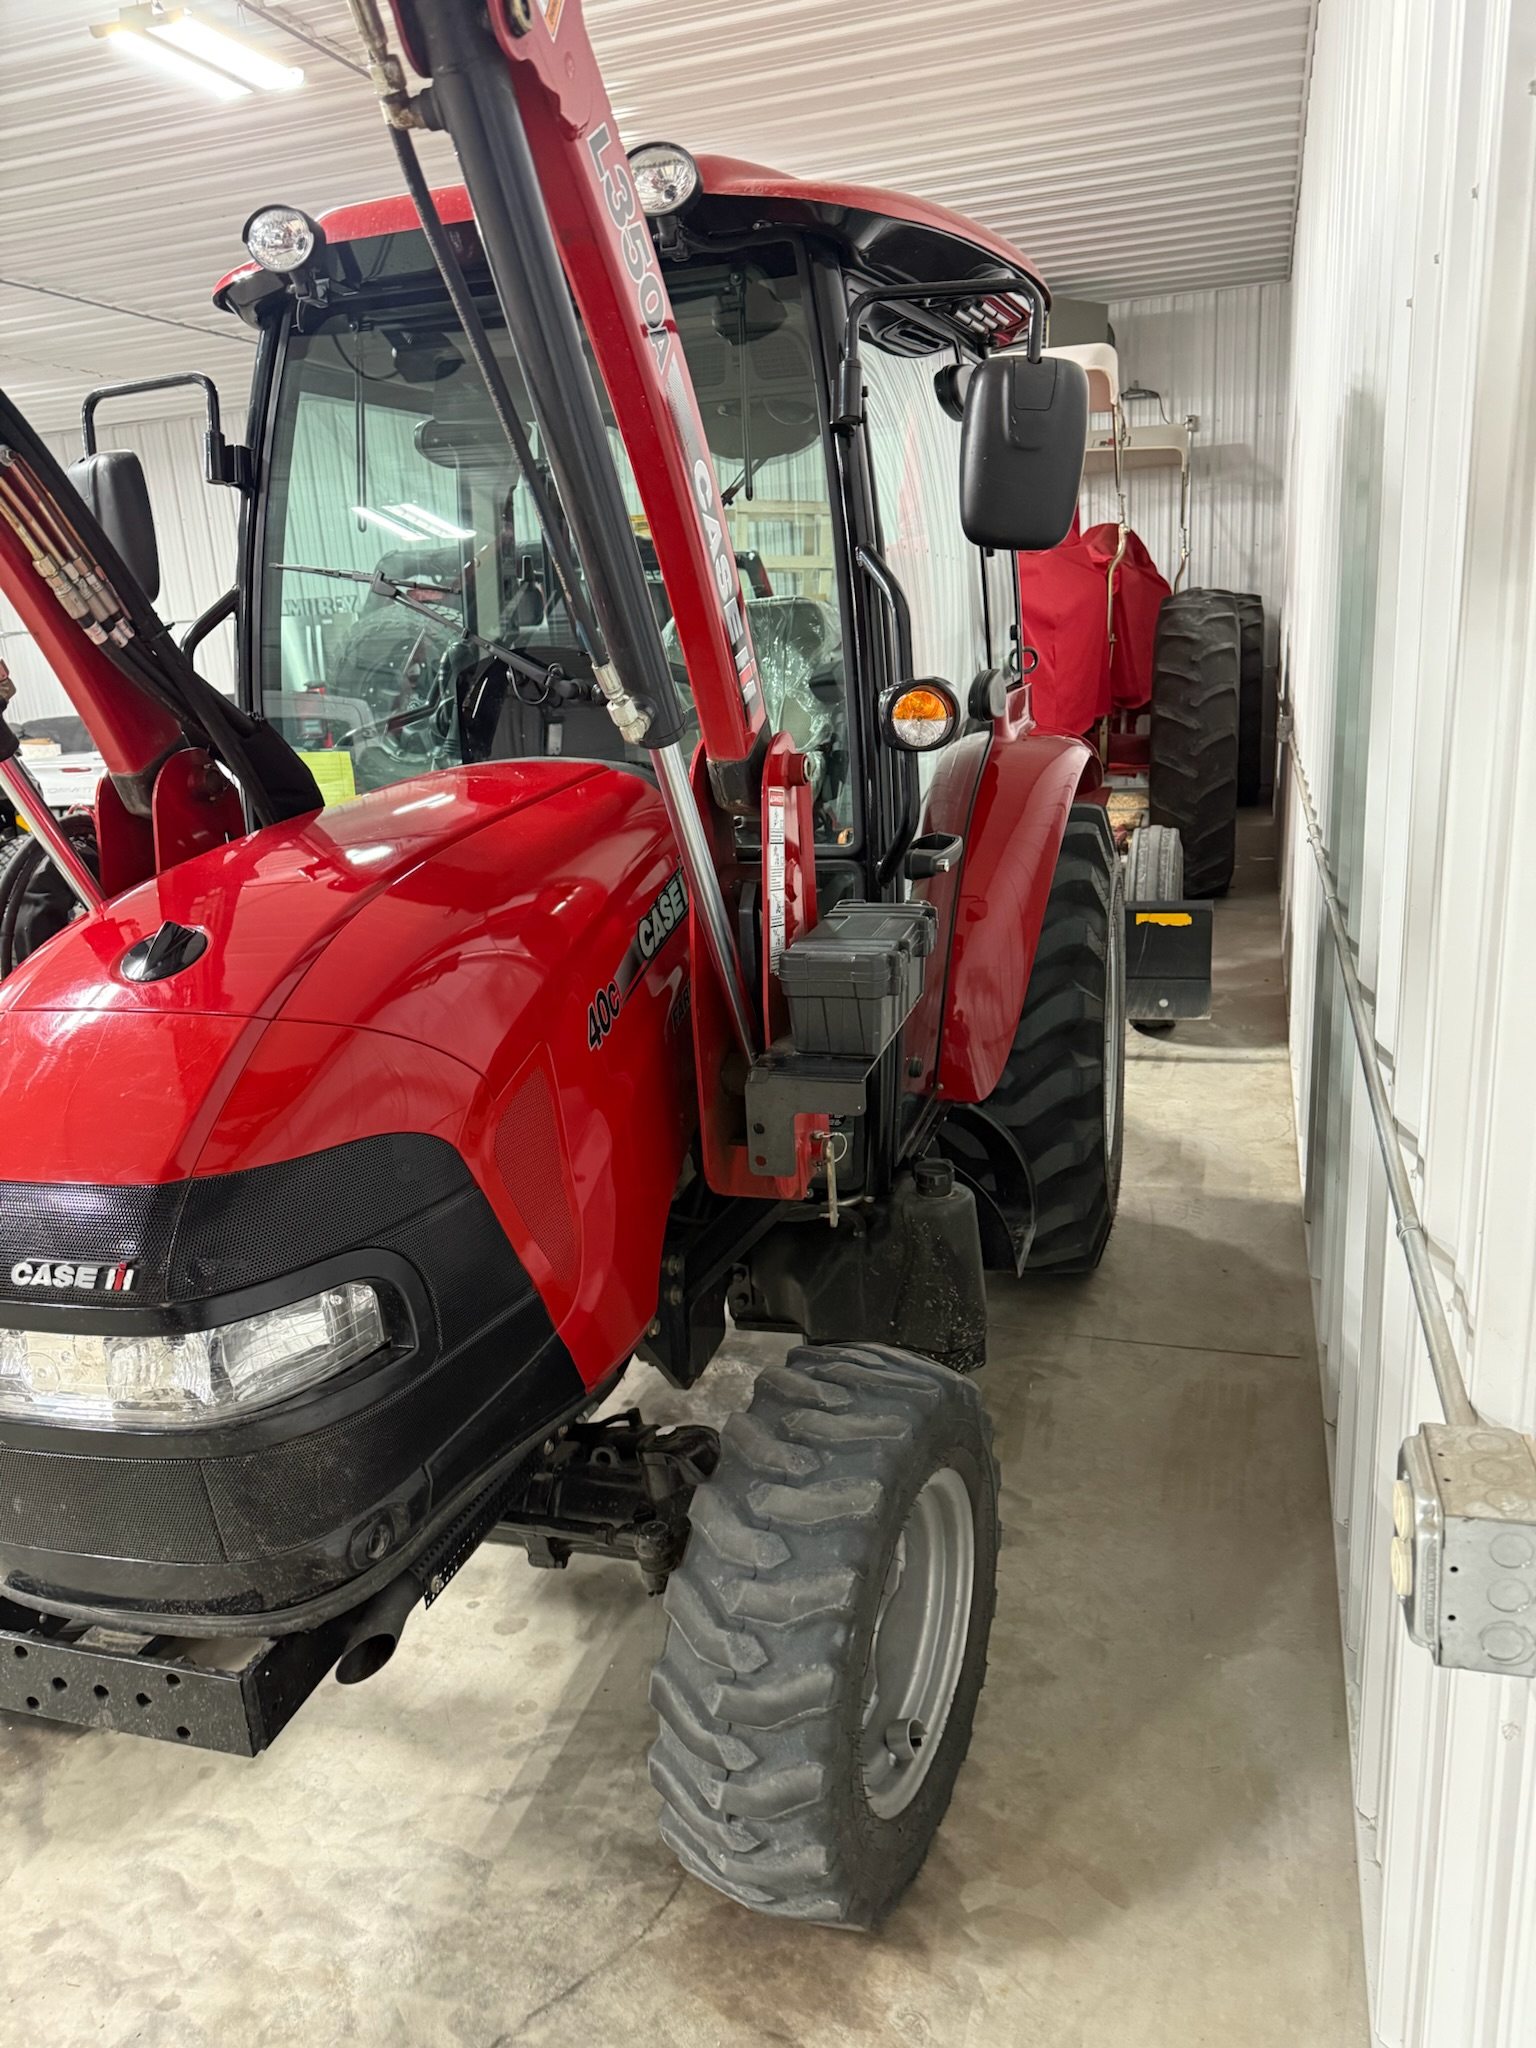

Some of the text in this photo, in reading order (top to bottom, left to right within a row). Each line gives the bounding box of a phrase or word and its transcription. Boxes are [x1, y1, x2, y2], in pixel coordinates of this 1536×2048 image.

[587, 122, 671, 375] L350A
[693, 458, 744, 646] CASE
[11, 1262, 98, 1289] CASE
